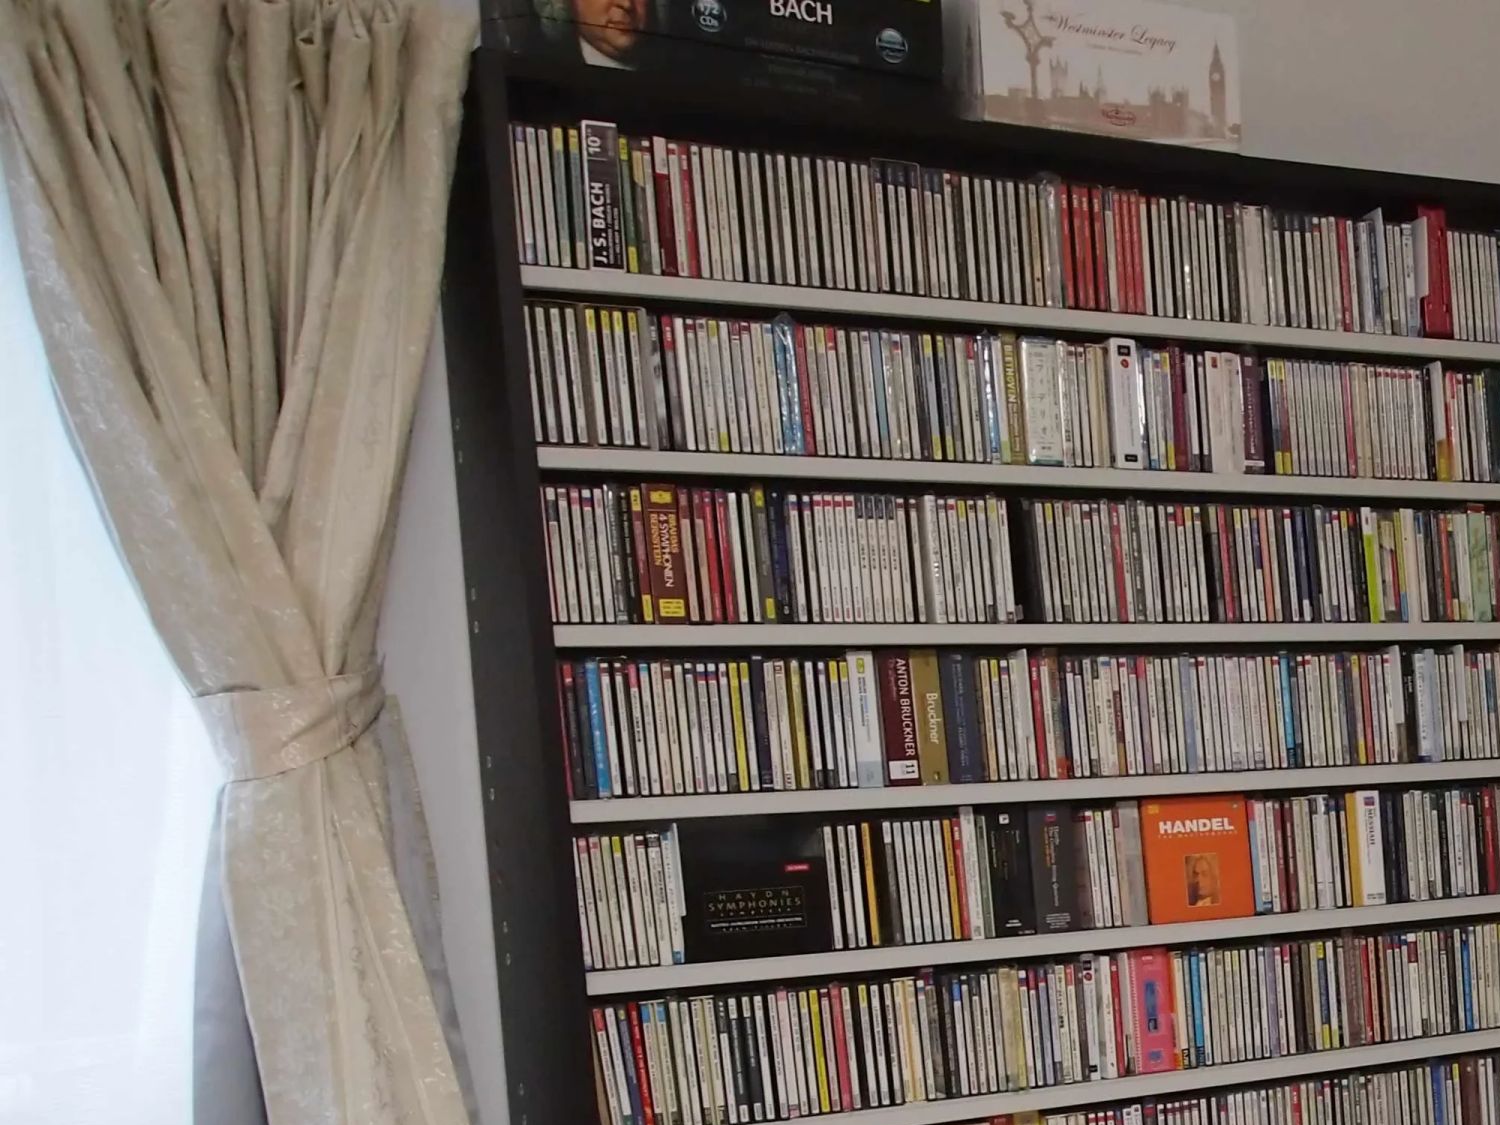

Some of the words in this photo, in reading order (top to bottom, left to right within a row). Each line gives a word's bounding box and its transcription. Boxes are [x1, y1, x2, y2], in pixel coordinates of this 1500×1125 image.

[769, 0, 833, 25] BACH
[1046, 14, 1125, 41] Westminster
[1129, 25, 1177, 54] Legacy
[590, 182, 606, 228] BACH
[1003, 343, 1018, 403] BEETHOVEN
[894, 658, 909, 695] ANTON
[899, 697, 917, 757] BRUCKNER
[925, 692, 939, 745] Bruckner
[1158, 816, 1236, 834] HANDEL
[707, 897, 802, 912] SYMPHONIES
[719, 889, 790, 901] HAYDN
